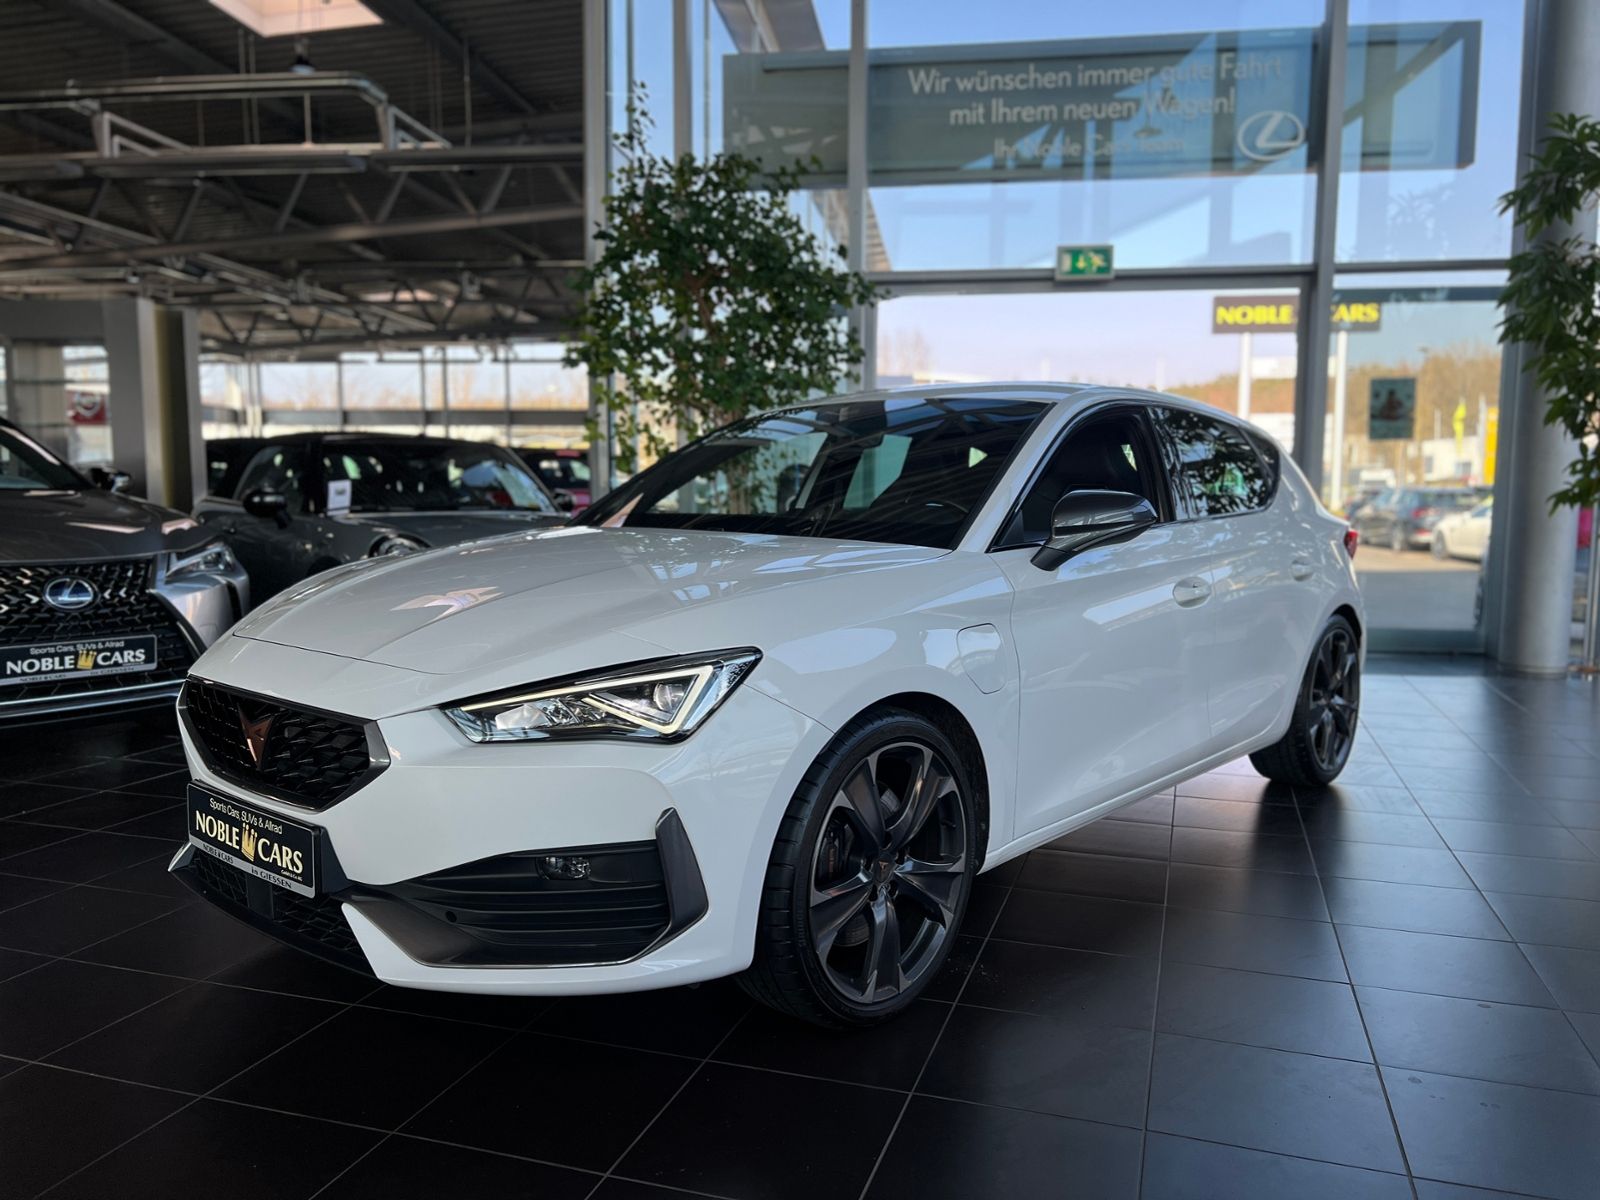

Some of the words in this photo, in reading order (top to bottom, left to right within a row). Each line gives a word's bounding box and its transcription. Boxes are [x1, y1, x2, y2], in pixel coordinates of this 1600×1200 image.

[908, 69, 950, 95] Wir
[955, 64, 1072, 92] wünschen
[1077, 64, 1154, 88] immer
[1219, 52, 1281, 80] Fahrt
[949, 102, 985, 126] mit
[991, 97, 1058, 125] Ihrem
[1063, 101, 1138, 122] neuen
[1215, 304, 1294, 326] NOBLE
[1331, 302, 1380, 323] ARS
[6, 655, 75, 675] NOBLE
[96, 648, 146, 666] CARS
[209, 797, 227, 814] Sports
[241, 810, 258, 827] SUVs
[258, 817, 264, 828] &
[264, 819, 283, 835] Allrad
[195, 810, 240, 850] NOBLE
[257, 837, 304, 874] CARS
